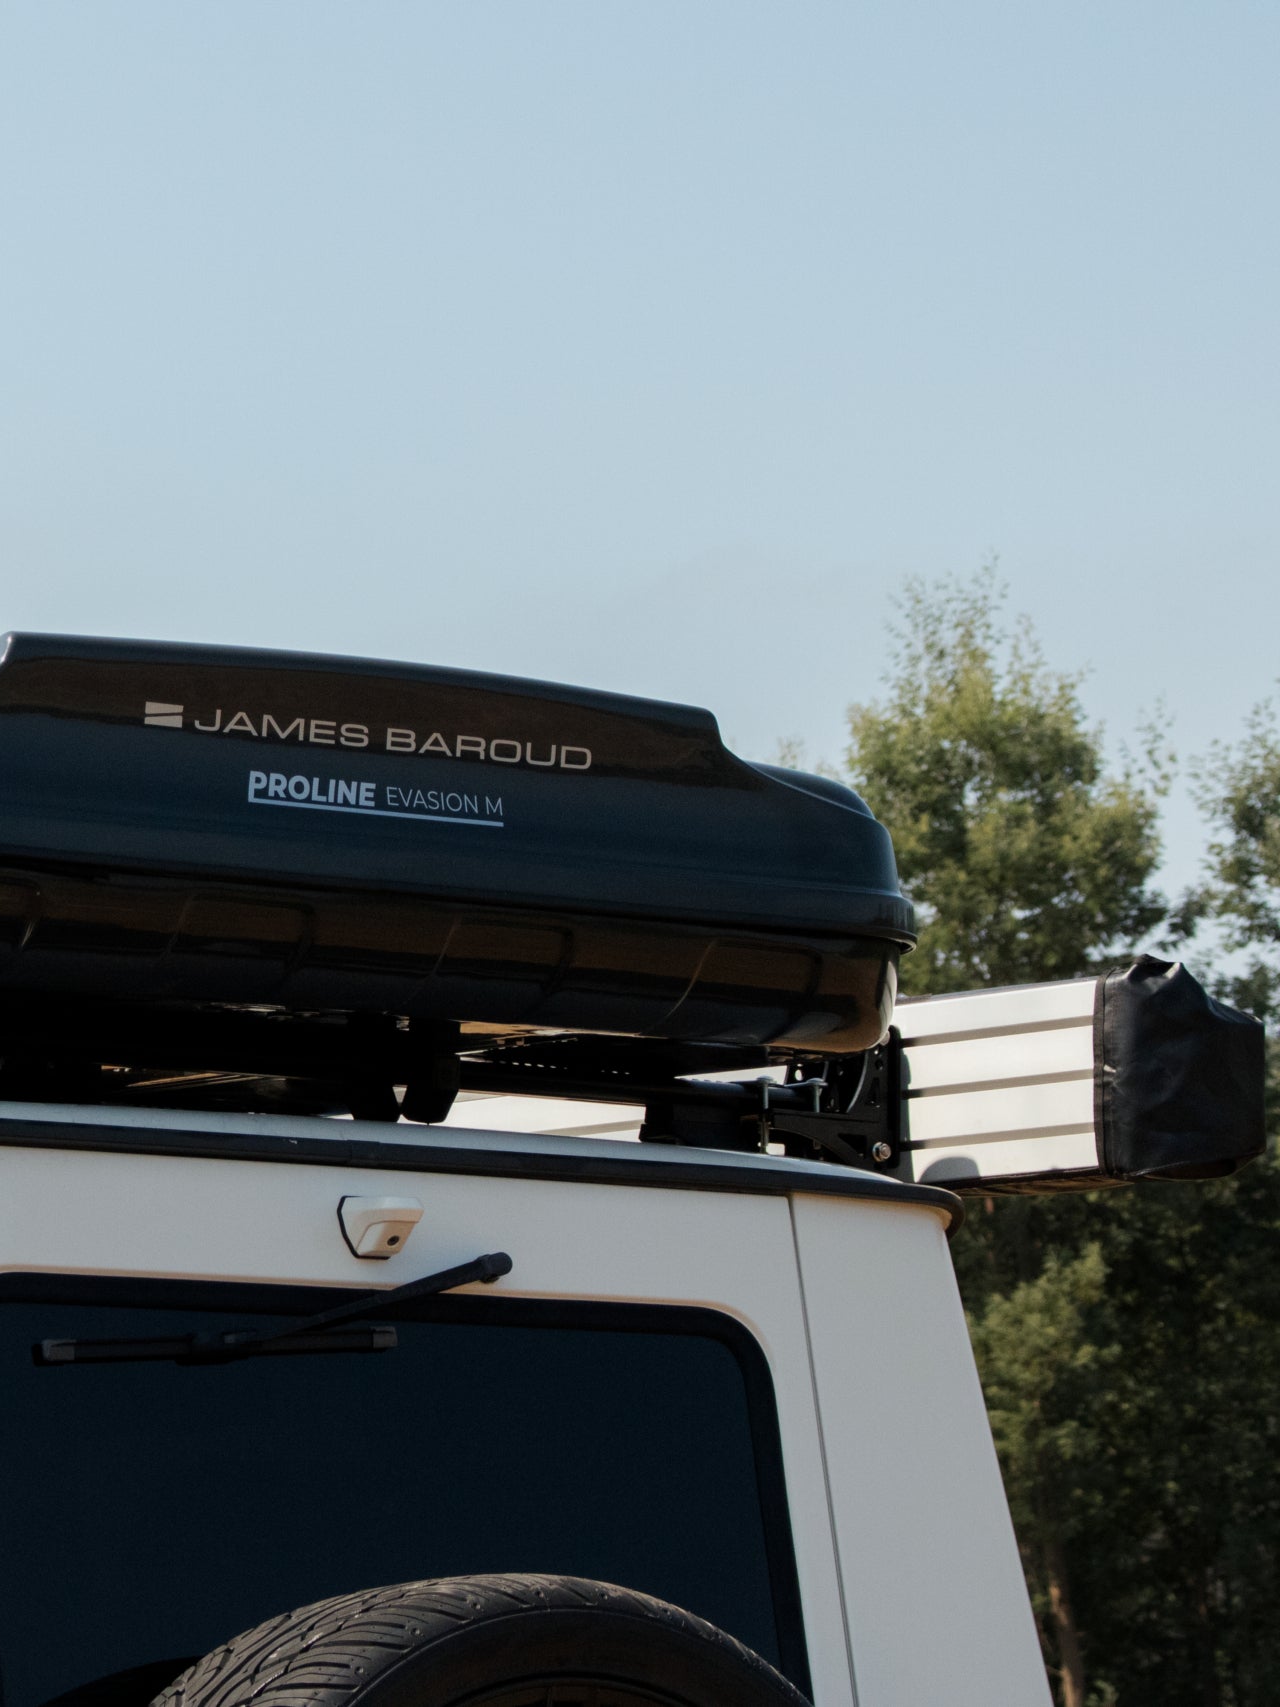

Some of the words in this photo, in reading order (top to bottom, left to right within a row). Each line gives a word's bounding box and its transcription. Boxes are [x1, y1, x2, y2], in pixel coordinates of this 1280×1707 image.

[194, 709, 369, 748] JAMES
[386, 727, 593, 770] BAROUD
[248, 770, 376, 807] PROLINE
[386, 786, 478, 815] EVASION
[485, 796, 503, 816] M
